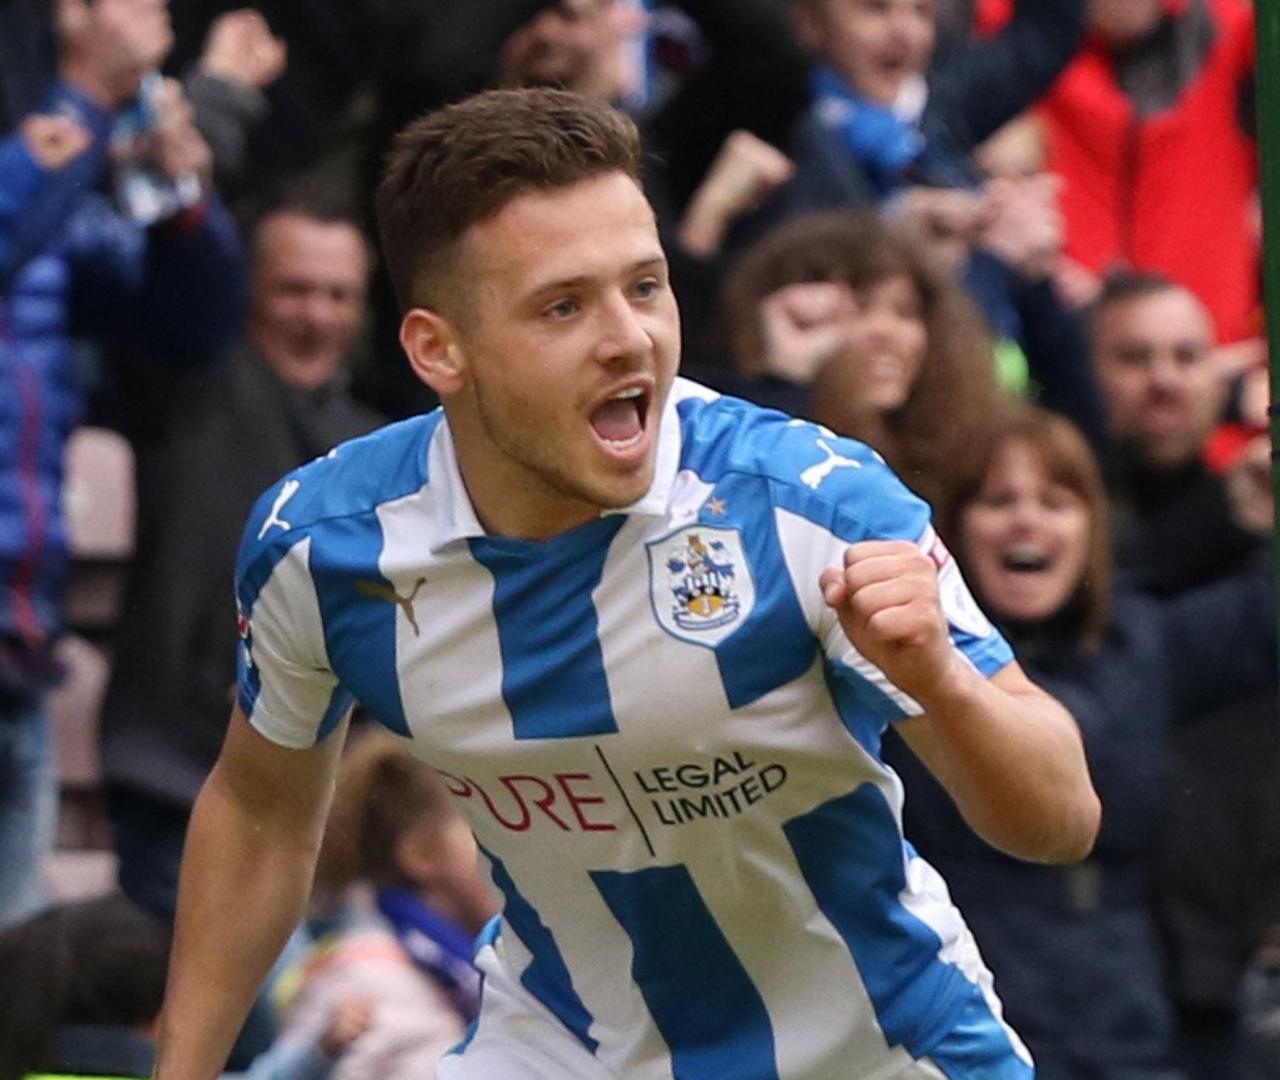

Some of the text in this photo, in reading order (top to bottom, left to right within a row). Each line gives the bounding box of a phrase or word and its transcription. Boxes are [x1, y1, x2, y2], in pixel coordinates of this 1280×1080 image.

[431, 766, 618, 832] PURE
[633, 751, 756, 794] LEGAL
[651, 763, 788, 826] LIMITED
